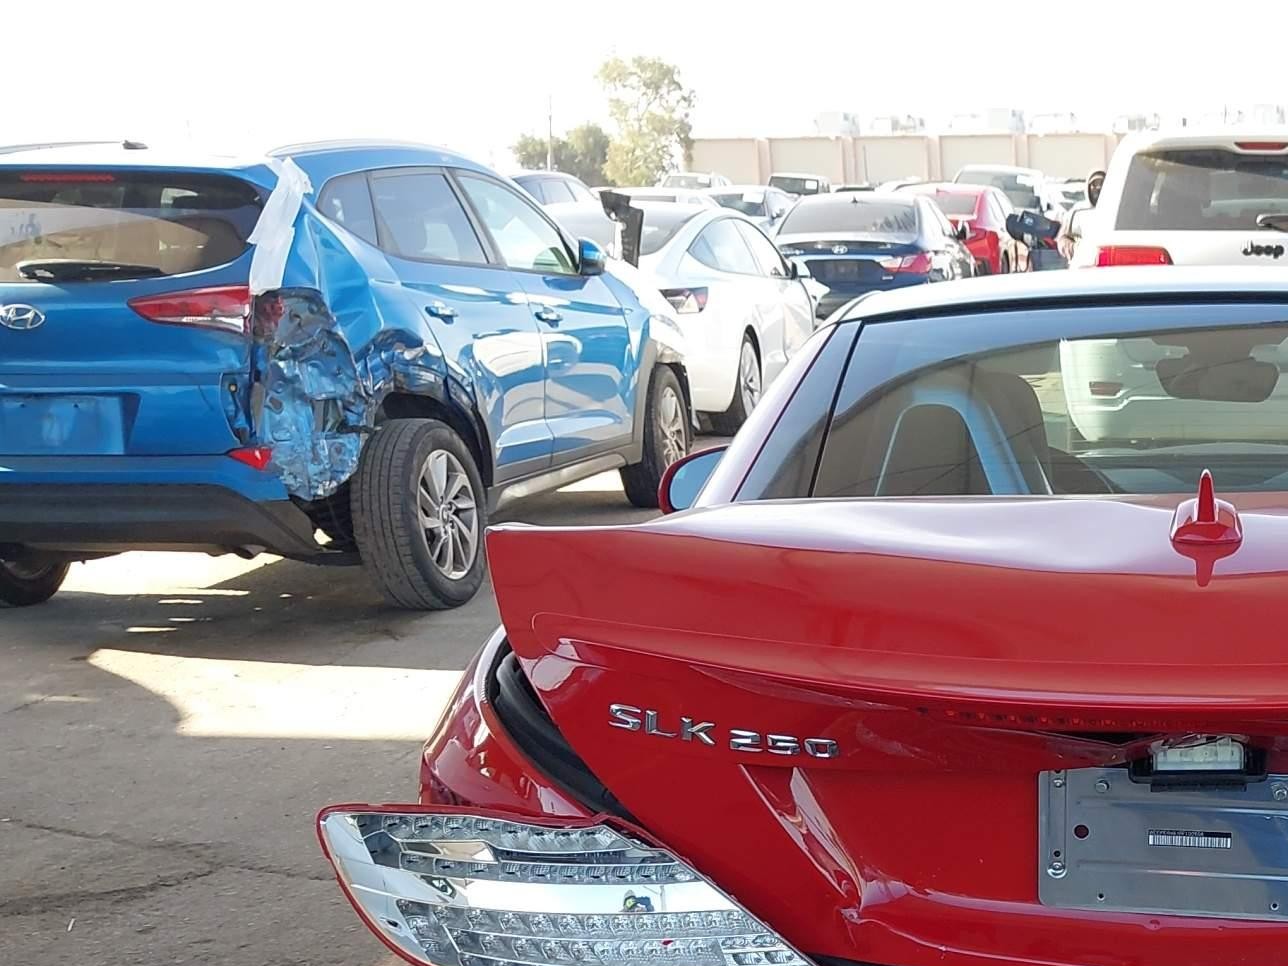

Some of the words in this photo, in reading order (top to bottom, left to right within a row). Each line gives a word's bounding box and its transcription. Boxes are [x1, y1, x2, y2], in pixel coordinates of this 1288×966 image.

[1242, 240, 1285, 260] Jeep
[608, 703, 716, 745] SLK
[729, 729, 841, 758] 250
